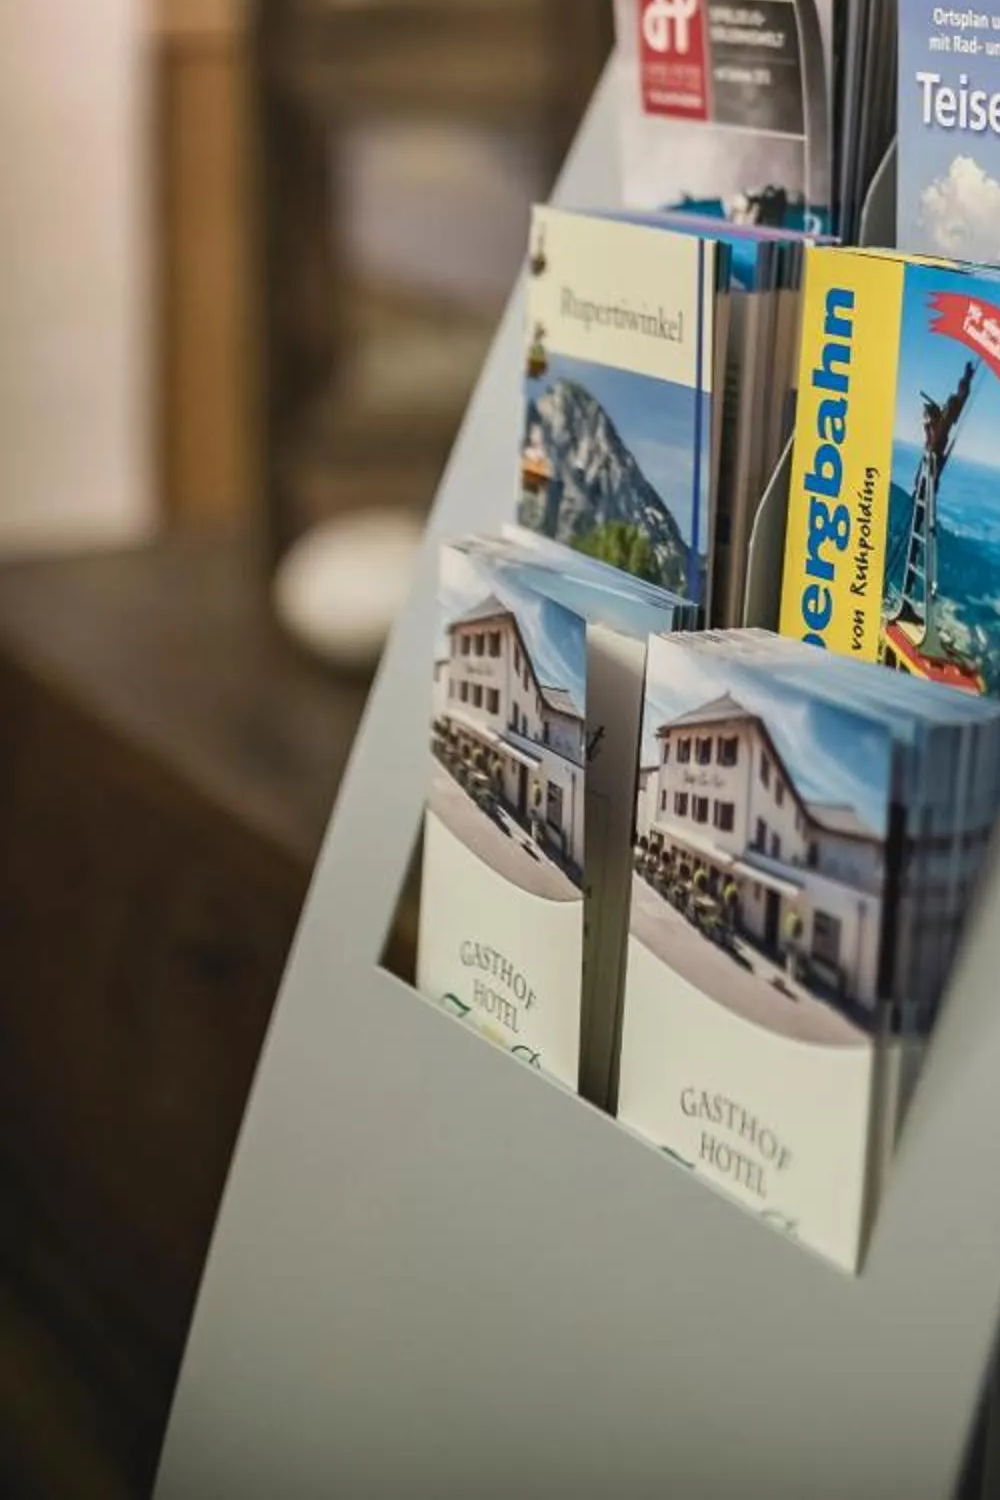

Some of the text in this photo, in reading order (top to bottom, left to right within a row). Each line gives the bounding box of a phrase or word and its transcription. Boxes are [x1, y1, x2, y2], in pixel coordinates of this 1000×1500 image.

[928, 35, 951, 52] mit
[952, 35, 984, 54] Rad-
[932, 6, 989, 32] Ortsplan
[849, 465, 881, 651] von Ruhpolding
[459, 939, 537, 1010] GASTHOF
[472, 978, 520, 1034] HOTEL
[679, 1085, 792, 1171] GASTHOF
[699, 1130, 768, 1201] HOTEL
